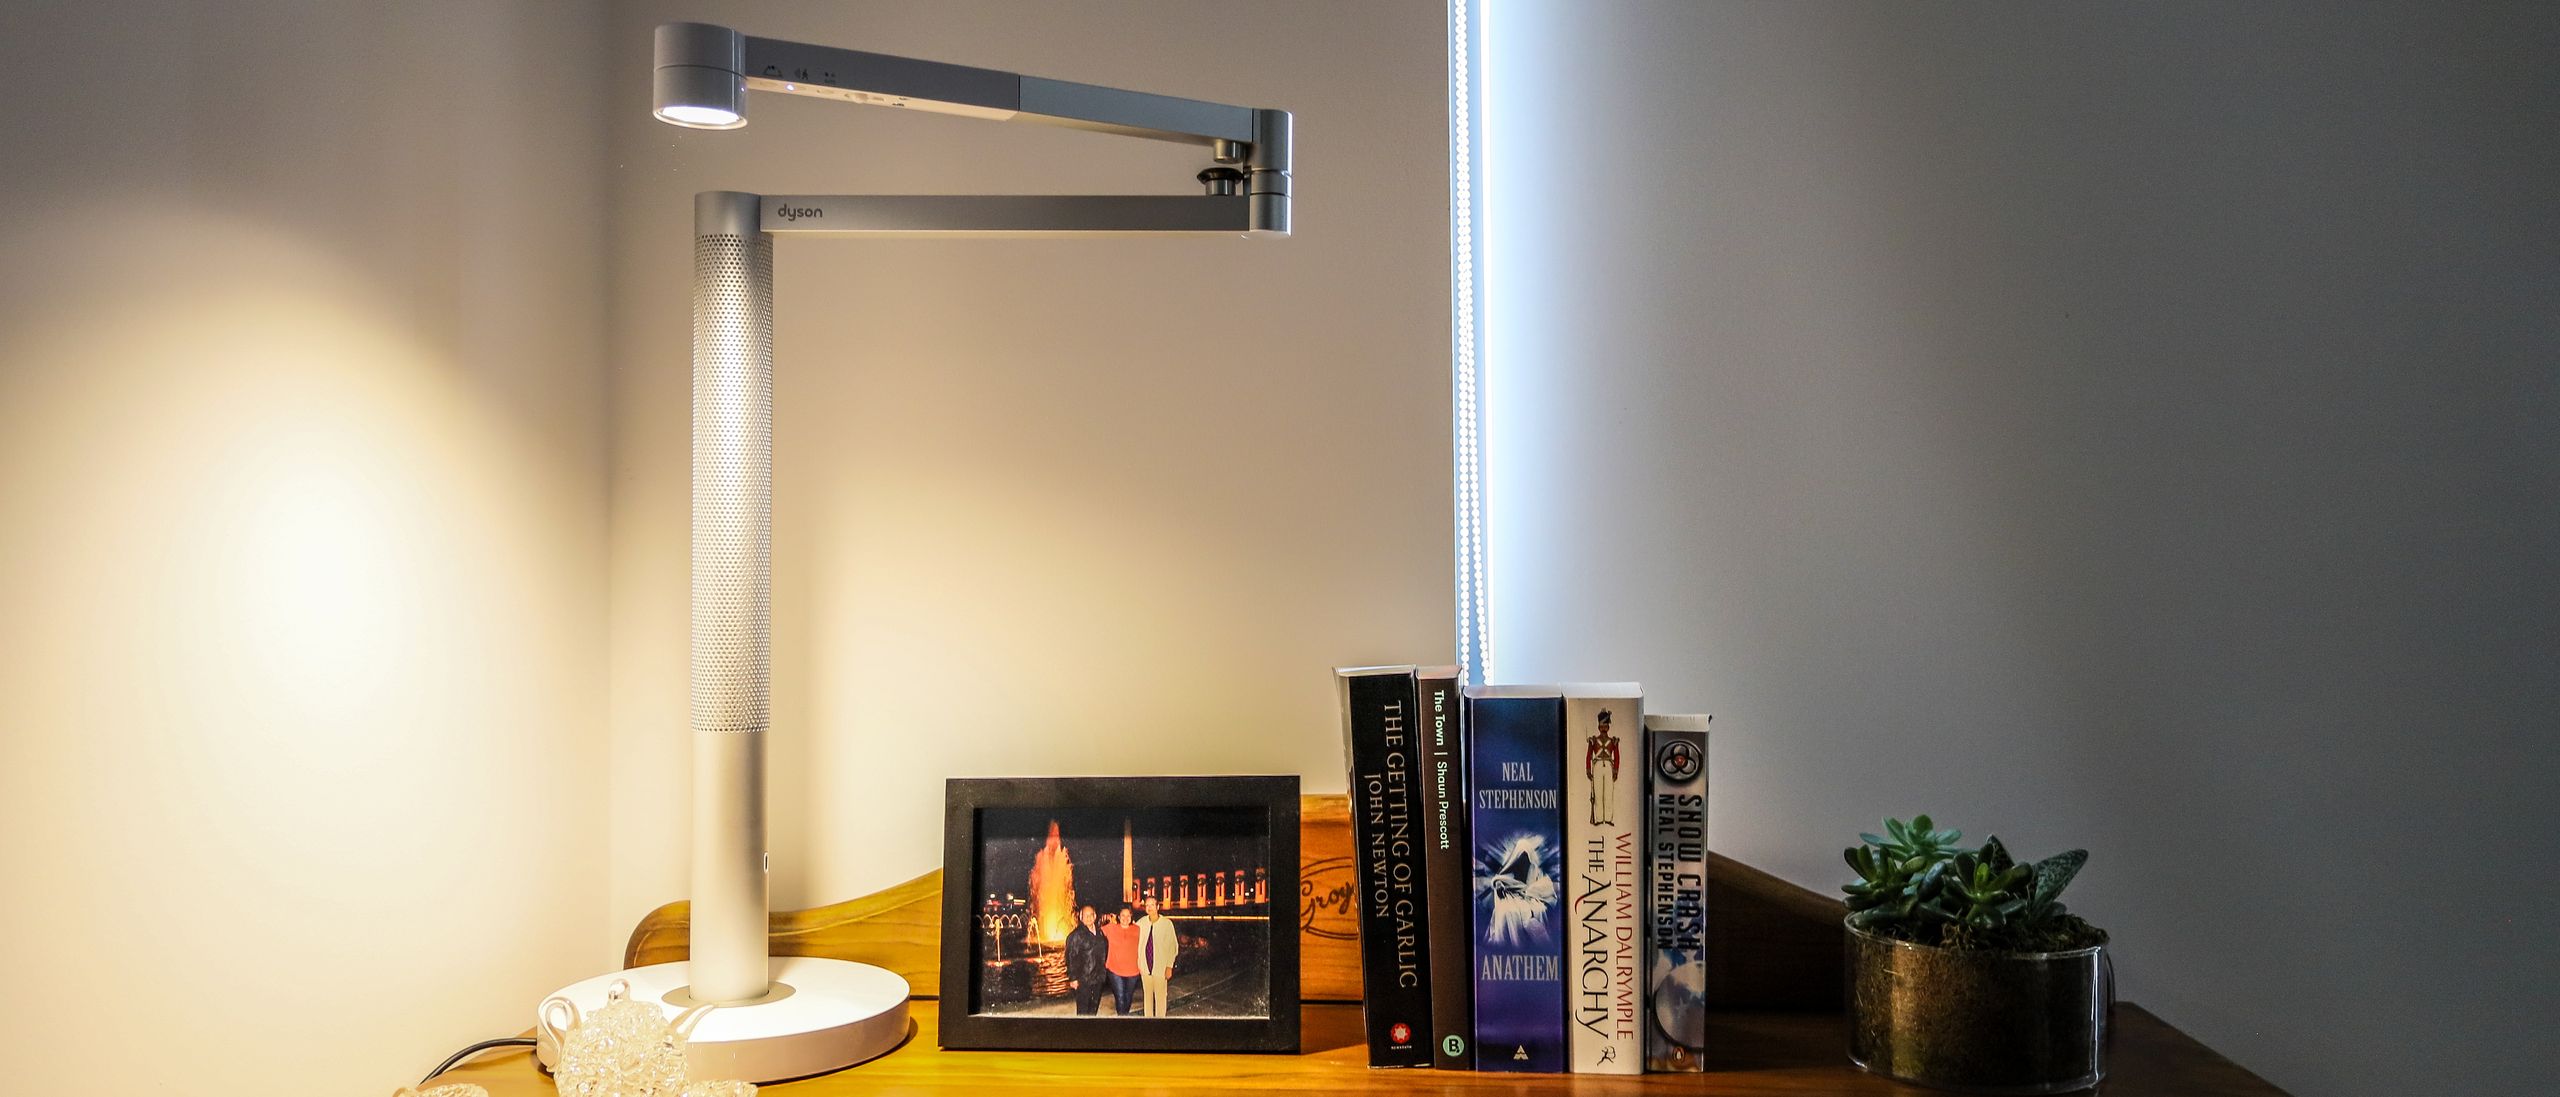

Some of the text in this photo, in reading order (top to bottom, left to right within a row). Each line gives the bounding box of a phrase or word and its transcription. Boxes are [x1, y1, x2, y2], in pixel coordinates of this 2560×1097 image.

[777, 202, 824, 222] dyson
[1434, 689, 1445, 712] The
[1435, 714, 1446, 746] Town
[1436, 761, 1448, 798] Shaun
[1502, 762, 1534, 782] NEAL
[1479, 789, 1557, 809] STEPHENSON
[1364, 773, 1389, 918] JOHN NEWTON
[1384, 700, 1418, 989] THE GETTING OF GARLIC
[1438, 801, 1450, 849] Prescott
[1657, 794, 1675, 950] NEAL STEPHENSON
[1676, 794, 1703, 951] SNOW CRASH
[1574, 835, 1612, 1040] THE ANARCHY
[1615, 832, 1634, 1041] WILLIAM DALRYMPLE
[1481, 954, 1559, 981] ANATHEM
